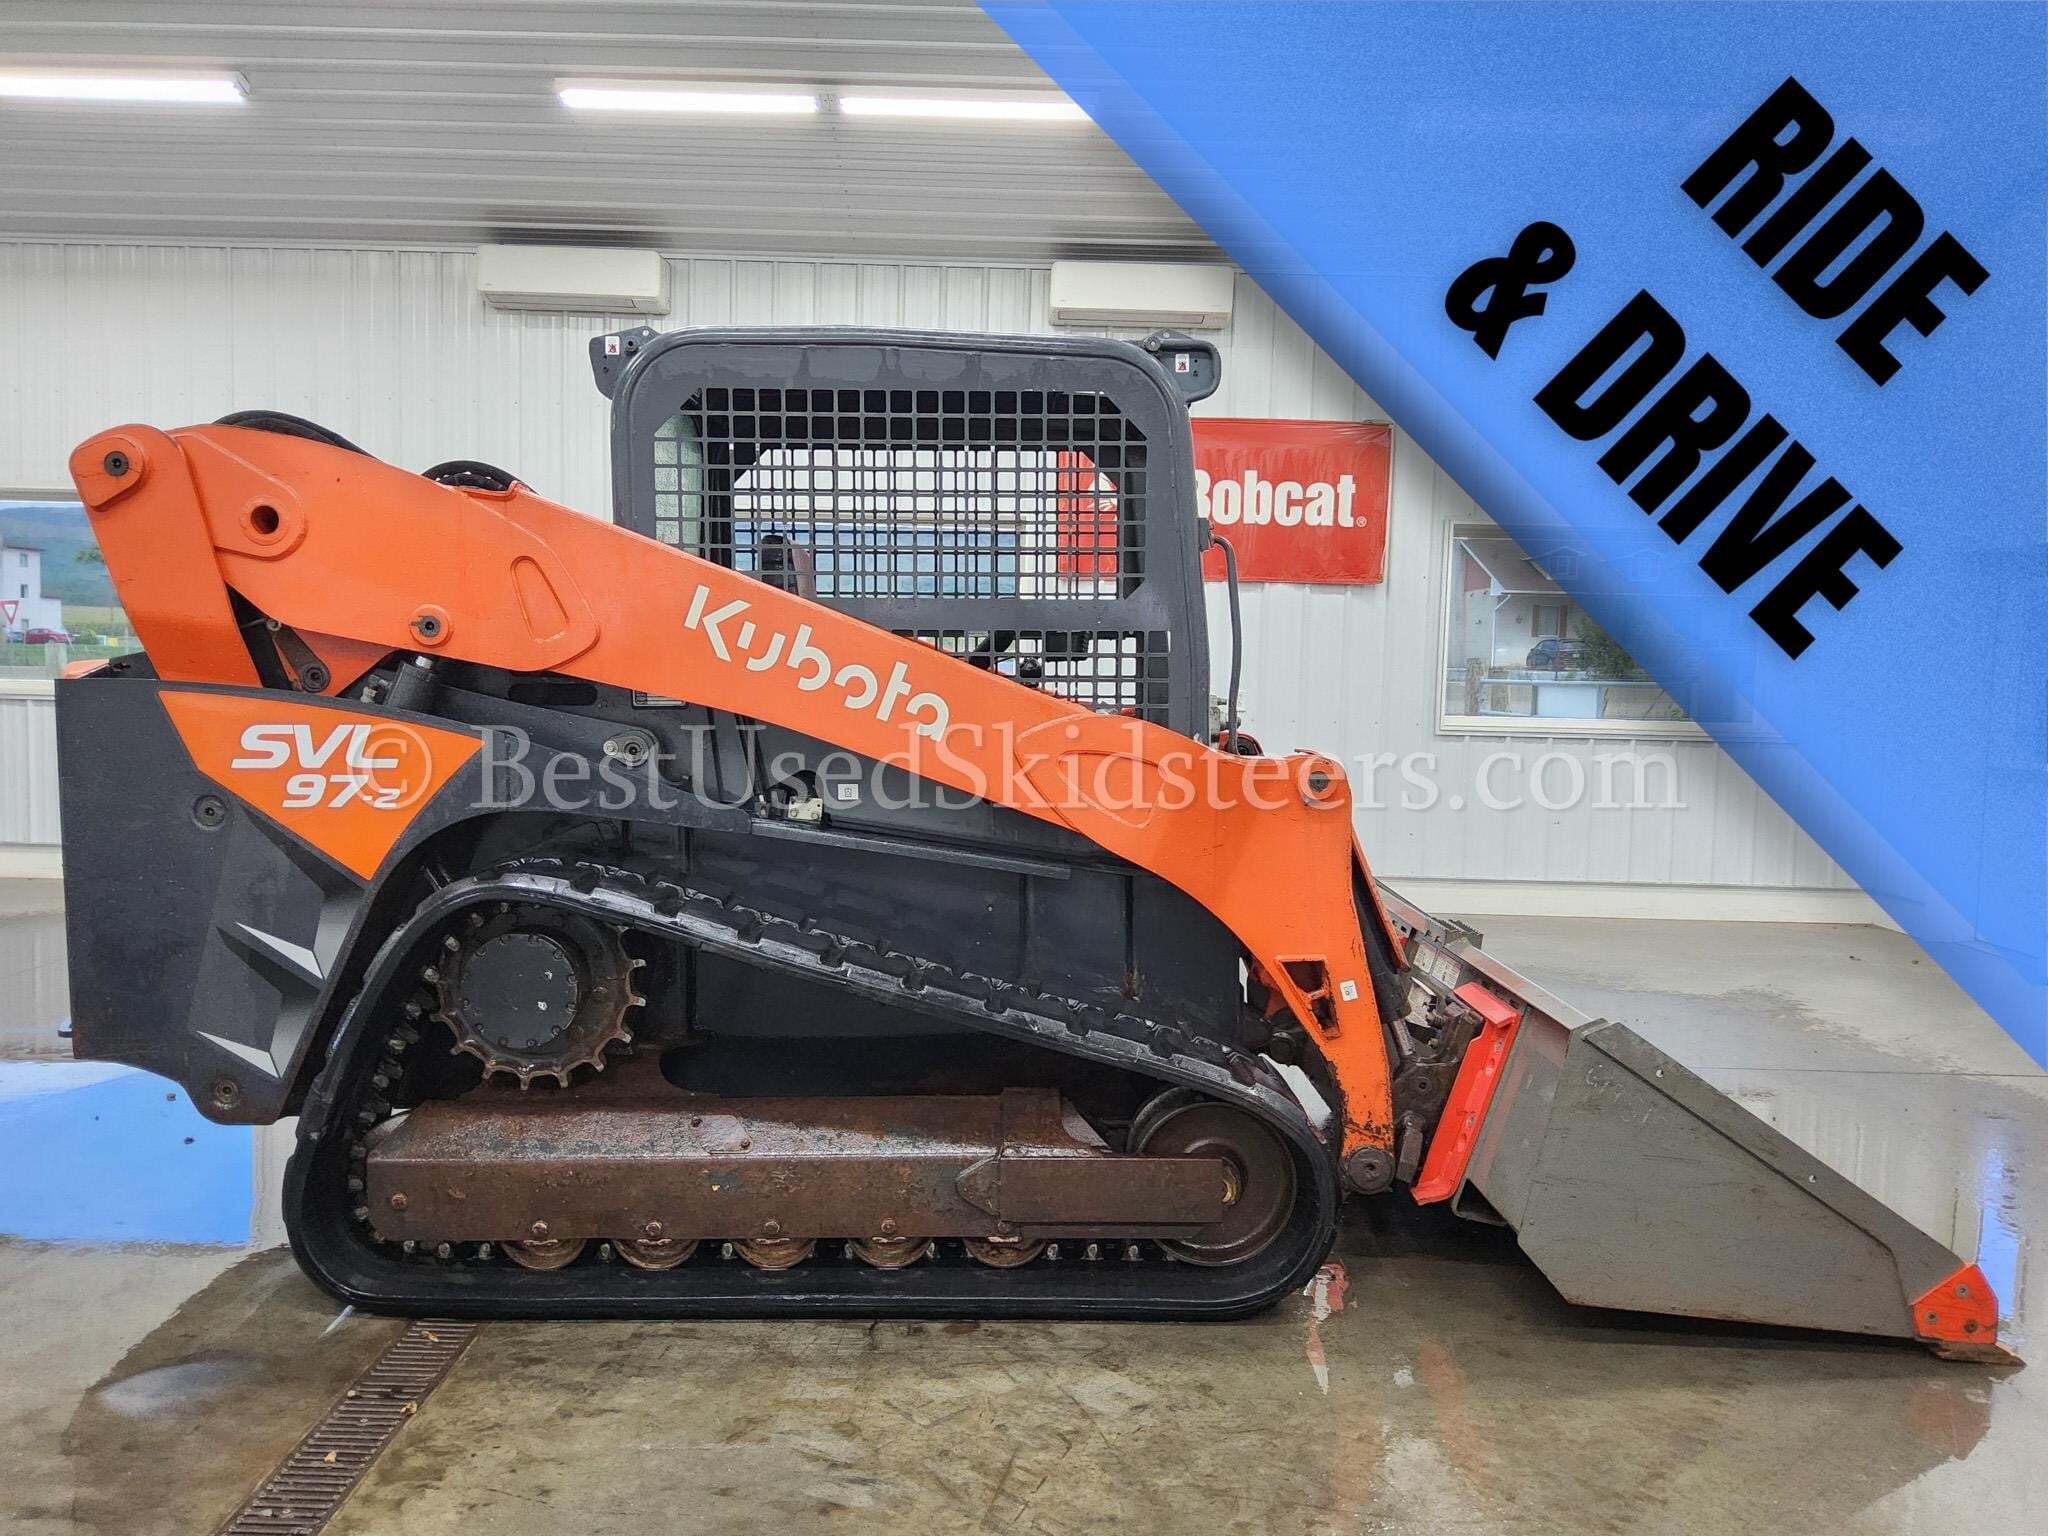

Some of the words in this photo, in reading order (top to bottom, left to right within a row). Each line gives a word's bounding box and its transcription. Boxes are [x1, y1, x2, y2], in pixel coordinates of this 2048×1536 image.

[684, 584, 950, 742] Kubota
[231, 724, 399, 768] SVL
[282, 774, 400, 808] 97-2
